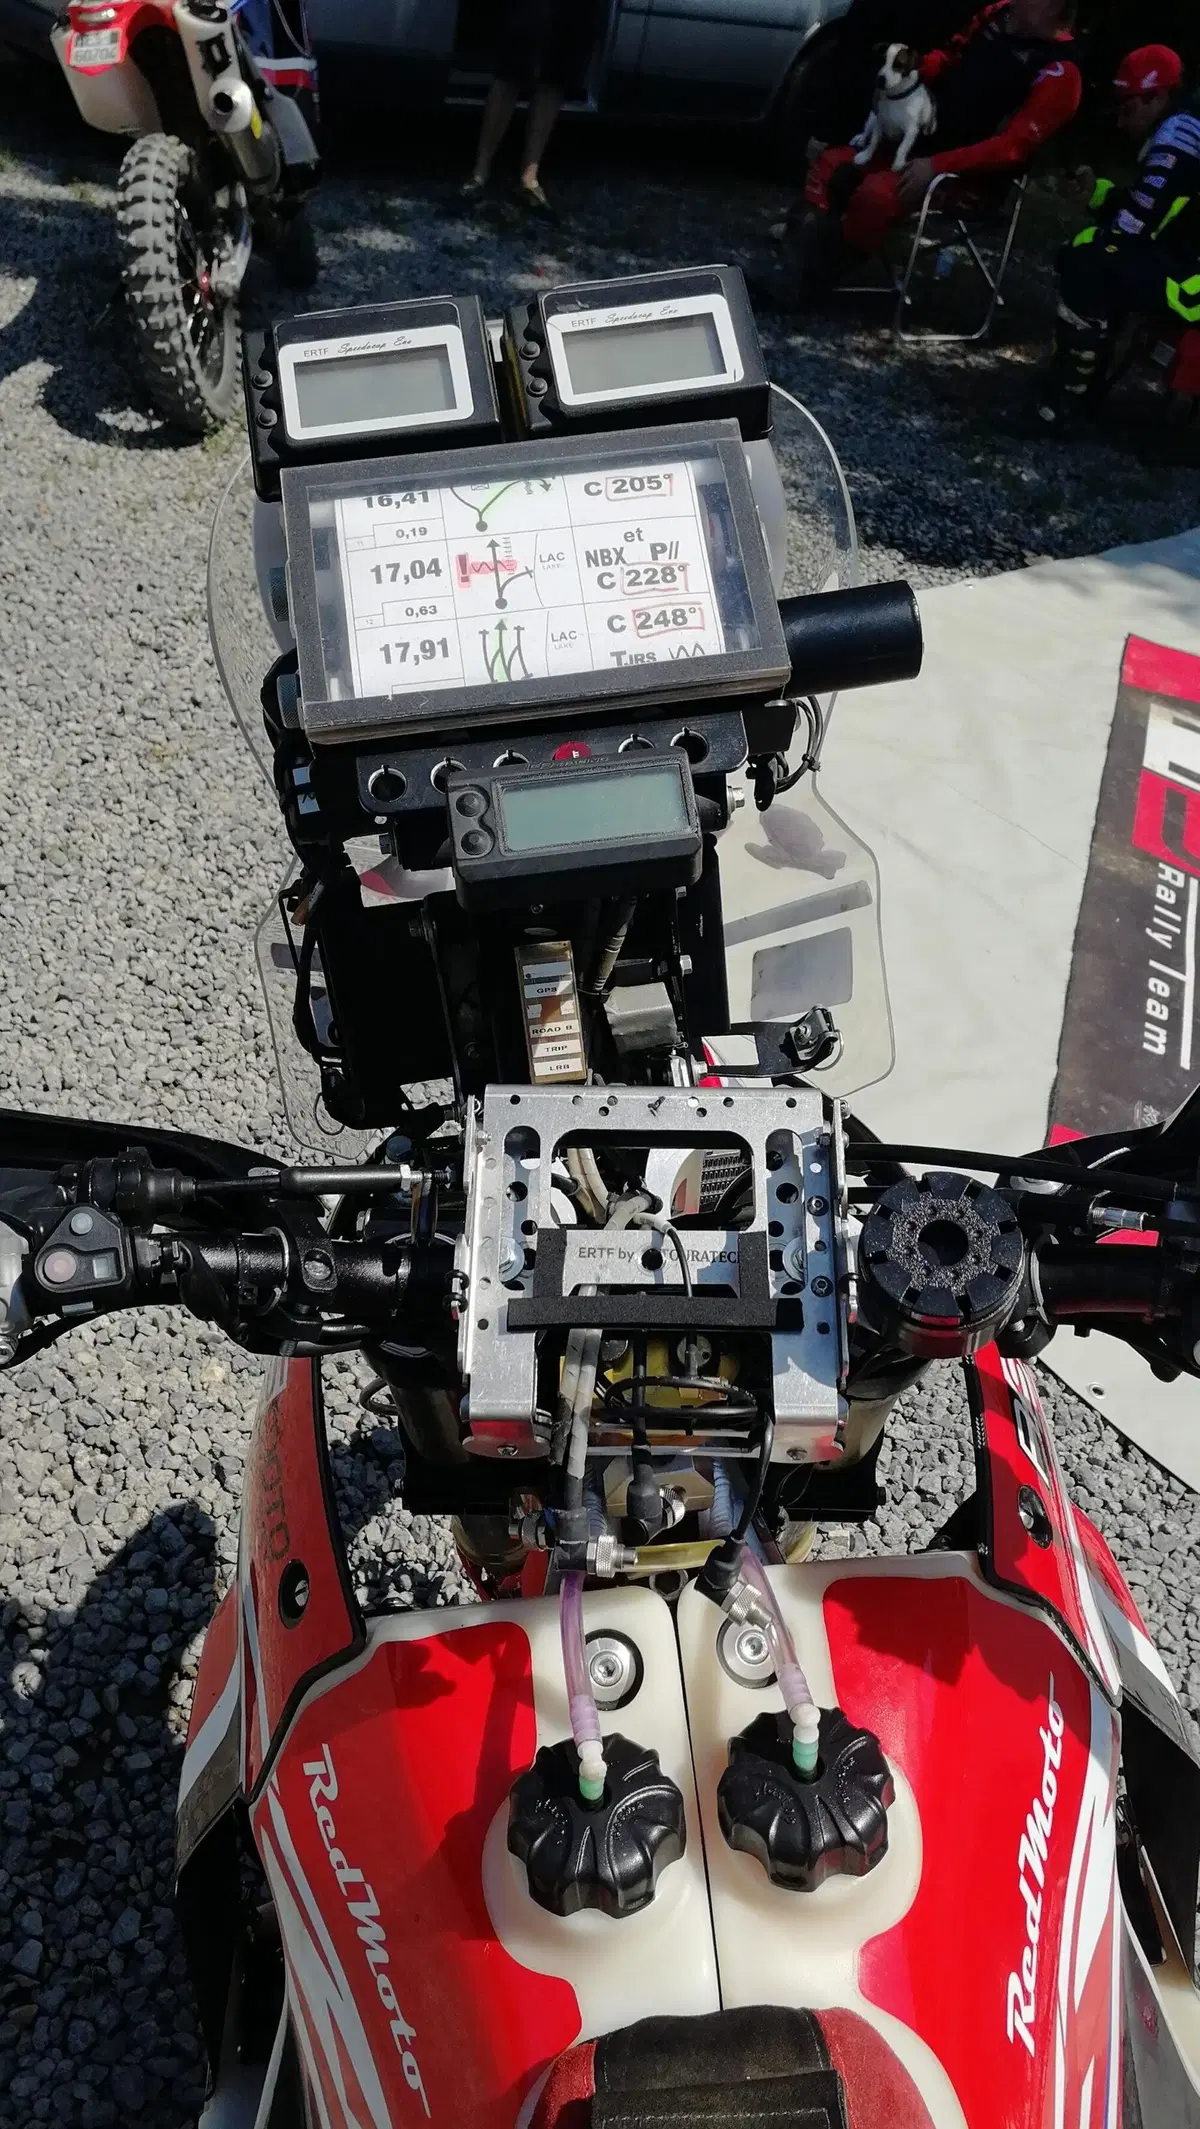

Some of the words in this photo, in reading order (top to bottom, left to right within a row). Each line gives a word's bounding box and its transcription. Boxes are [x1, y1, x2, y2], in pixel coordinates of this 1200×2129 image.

[571, 317, 597, 328] ERTF
[303, 347, 329, 358] ERTF
[583, 481, 603, 496] C
[363, 490, 430, 509] 16,41
[395, 526, 428, 540] 0,19
[623, 527, 644, 543] et
[539, 552, 565, 563] LAC
[584, 546, 627, 568] NBX
[370, 557, 443, 585] 17,04
[596, 571, 616, 590] C
[404, 605, 438, 618] 0,63
[606, 614, 627, 633] C
[550, 630, 578, 642] LAC
[379, 637, 450, 666] 17,91
[1145, 862, 1186, 950] Rally
[536, 986, 557, 994] GPS
[1142, 958, 1190, 1056] Team
[531, 1026, 561, 1035] ROAD
[544, 1045, 568, 1053] TRIP
[578, 1246, 615, 1259] ERTF
[618, 1246, 635, 1263] by
[661, 1248, 740, 1264] TOURATEC
[1006, 1670, 1065, 2058] RedMoto
[302, 1742, 433, 2120] RedMoto
